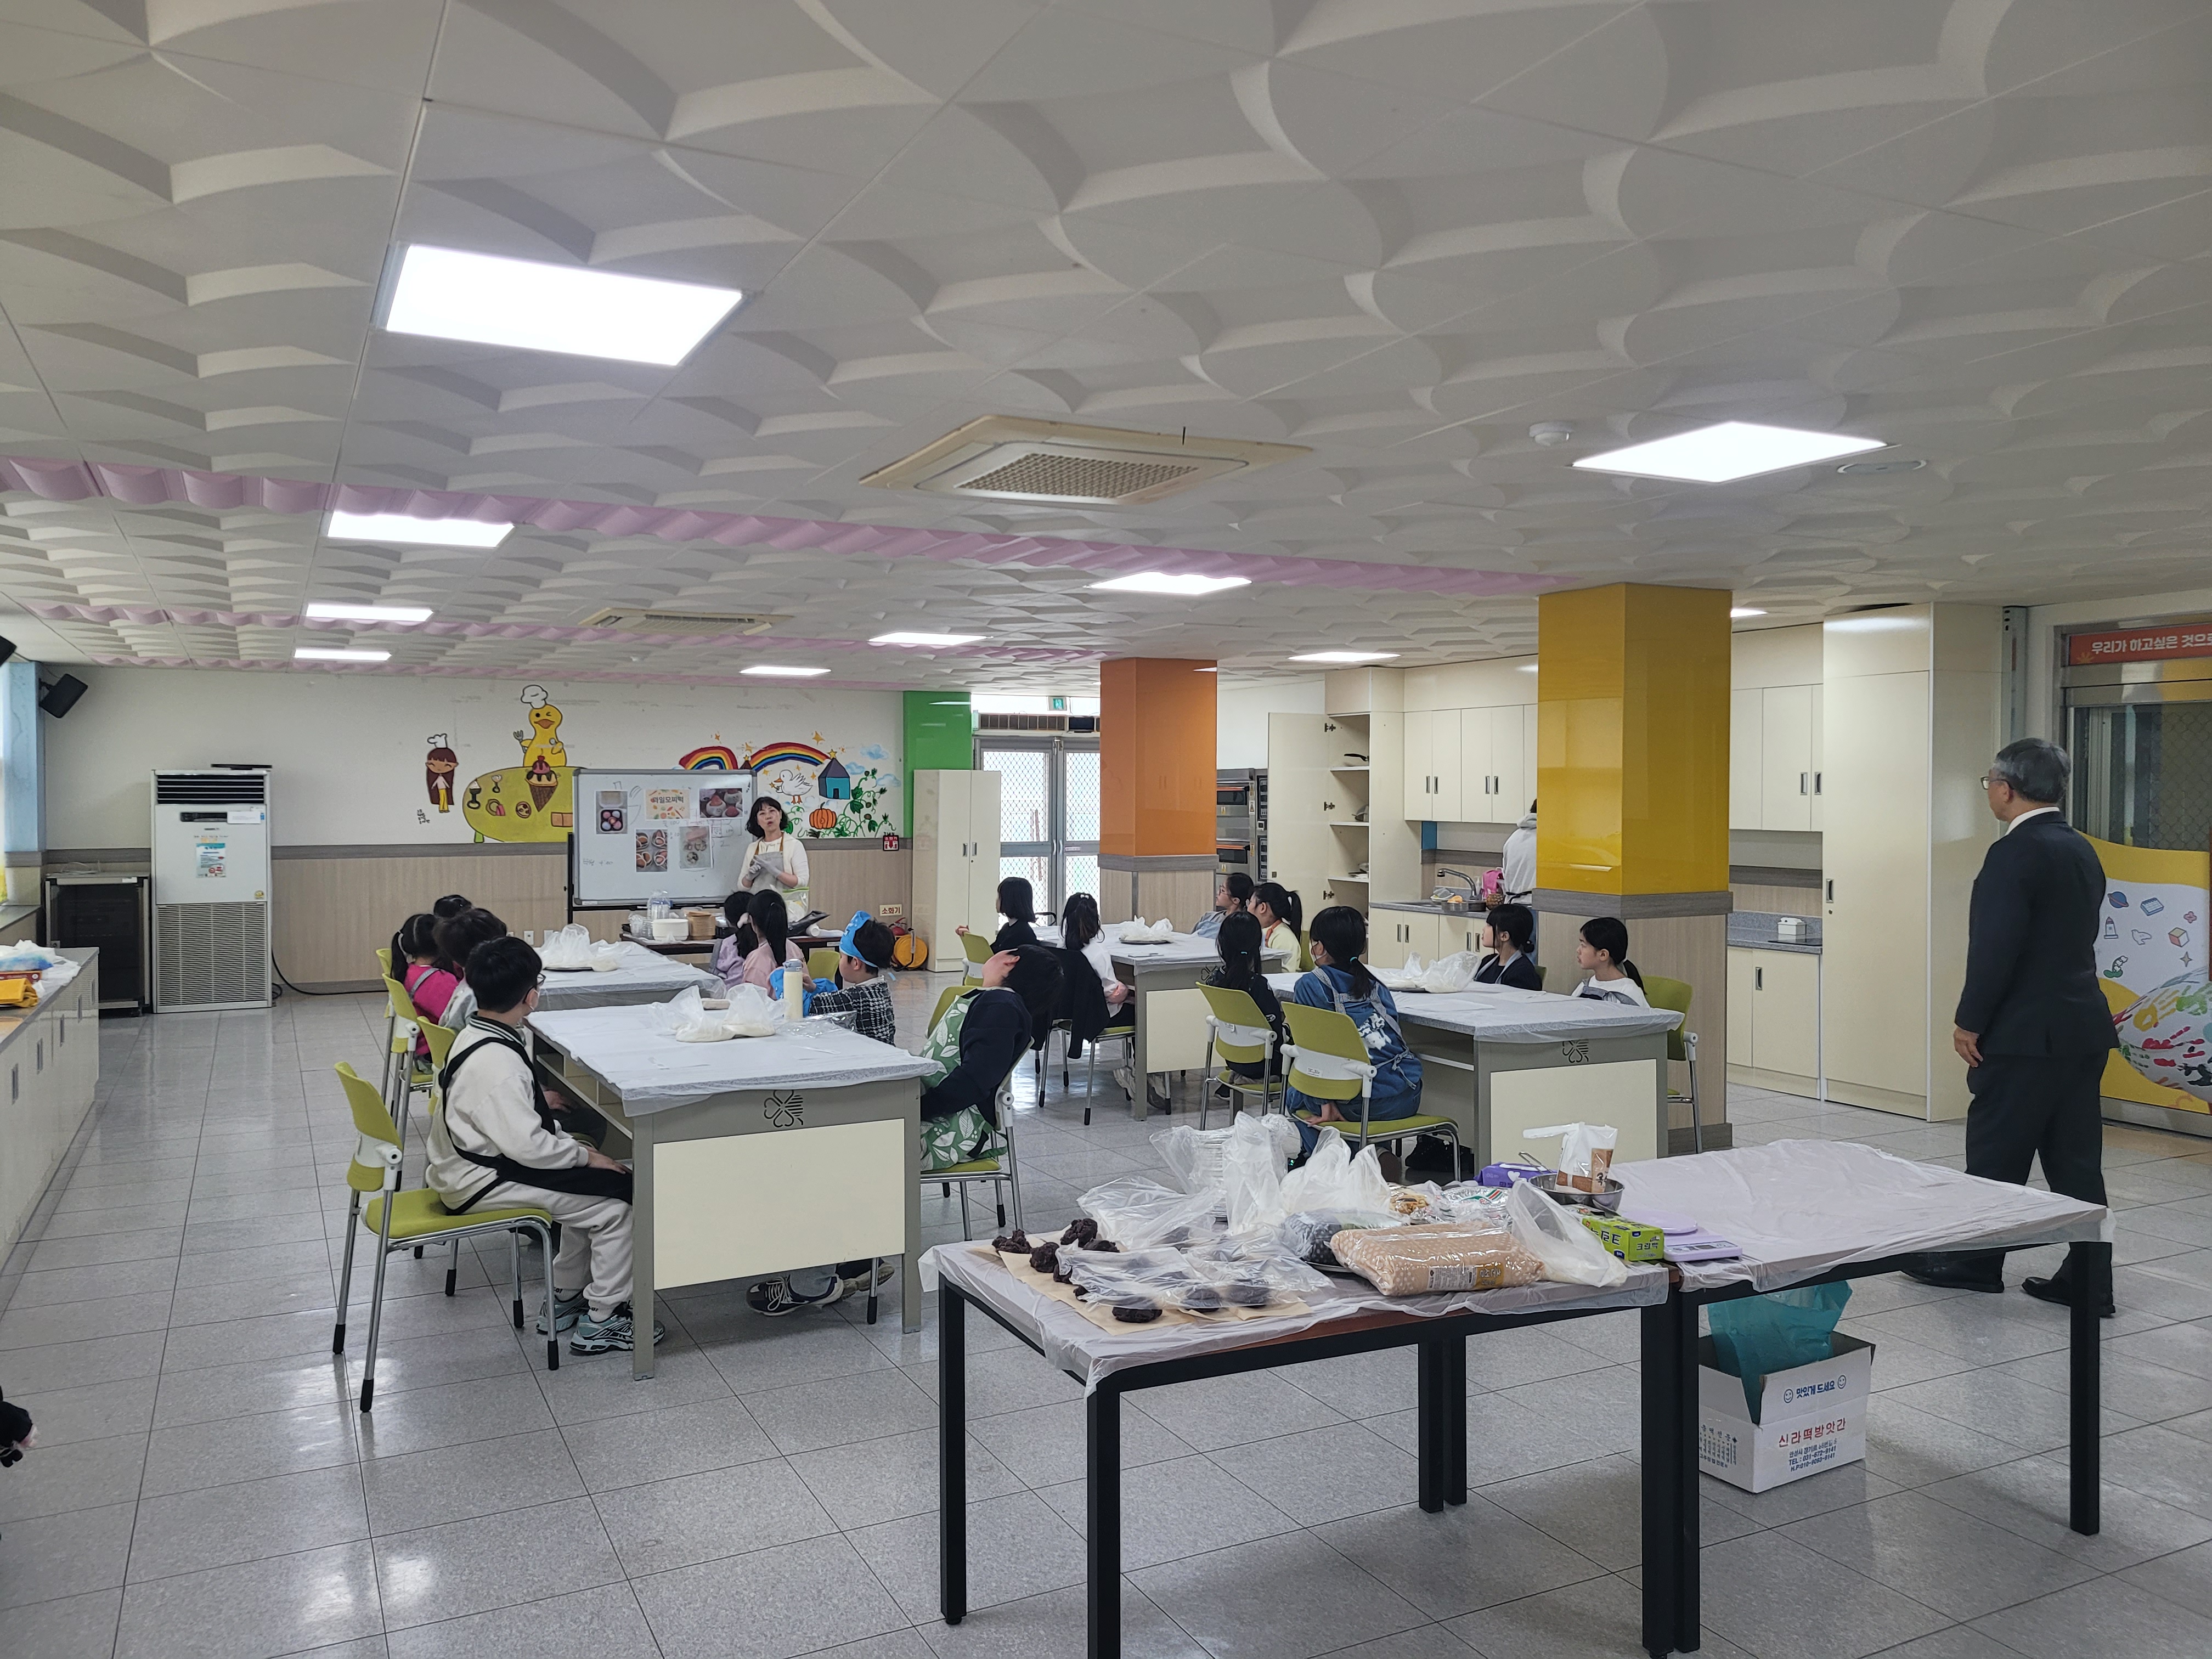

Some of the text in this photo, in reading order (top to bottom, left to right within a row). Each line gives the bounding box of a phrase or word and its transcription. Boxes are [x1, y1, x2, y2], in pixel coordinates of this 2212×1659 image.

[2092, 640, 2126, 654] 우리가
[2130, 635, 2177, 651] 하고싶은
[1796, 1380, 1835, 1399] 맛있게 드세요
[1779, 1418, 1846, 1448] 신라떡방앗간
[1788, 1458, 1799, 1466] TEL
